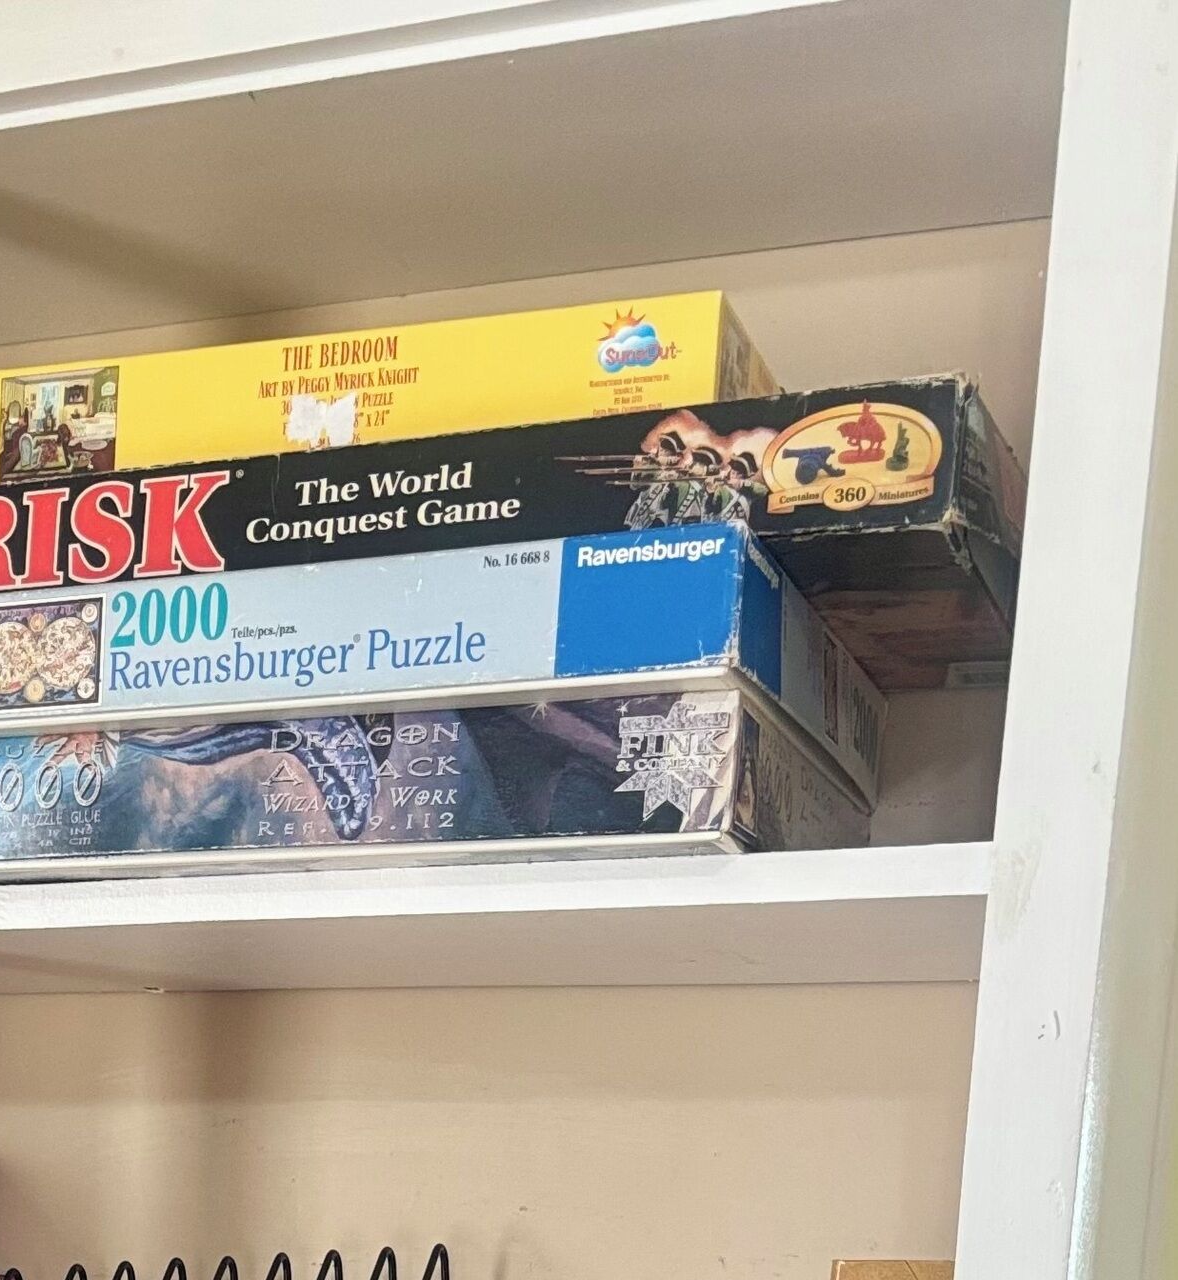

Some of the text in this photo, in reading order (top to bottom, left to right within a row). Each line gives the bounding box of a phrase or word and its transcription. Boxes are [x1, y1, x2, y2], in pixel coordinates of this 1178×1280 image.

[282, 335, 399, 372] THE BEDROOM
[258, 366, 420, 399] ART BY PEGGY MYRICK KNIGHT
[361, 391, 395, 409] PUZZLE
[294, 462, 473, 508] The World
[778, 486, 930, 504] Contains 360 Miniatures
[245, 496, 522, 545] Conquest Game
[482, 550, 551, 570] No. 16 668 8
[577, 535, 726, 568] Ravensburger
[110, 582, 229, 650] 2000
[110, 621, 487, 691] Ravensburger Puzzle
[269, 721, 462, 754] DRAGON
[616, 729, 729, 759] FINK
[261, 755, 462, 787] ATTACK
[615, 756, 727, 772] & COMPANY
[389, 786, 458, 808] WORK
[21, 812, 63, 827] PUZZLE
